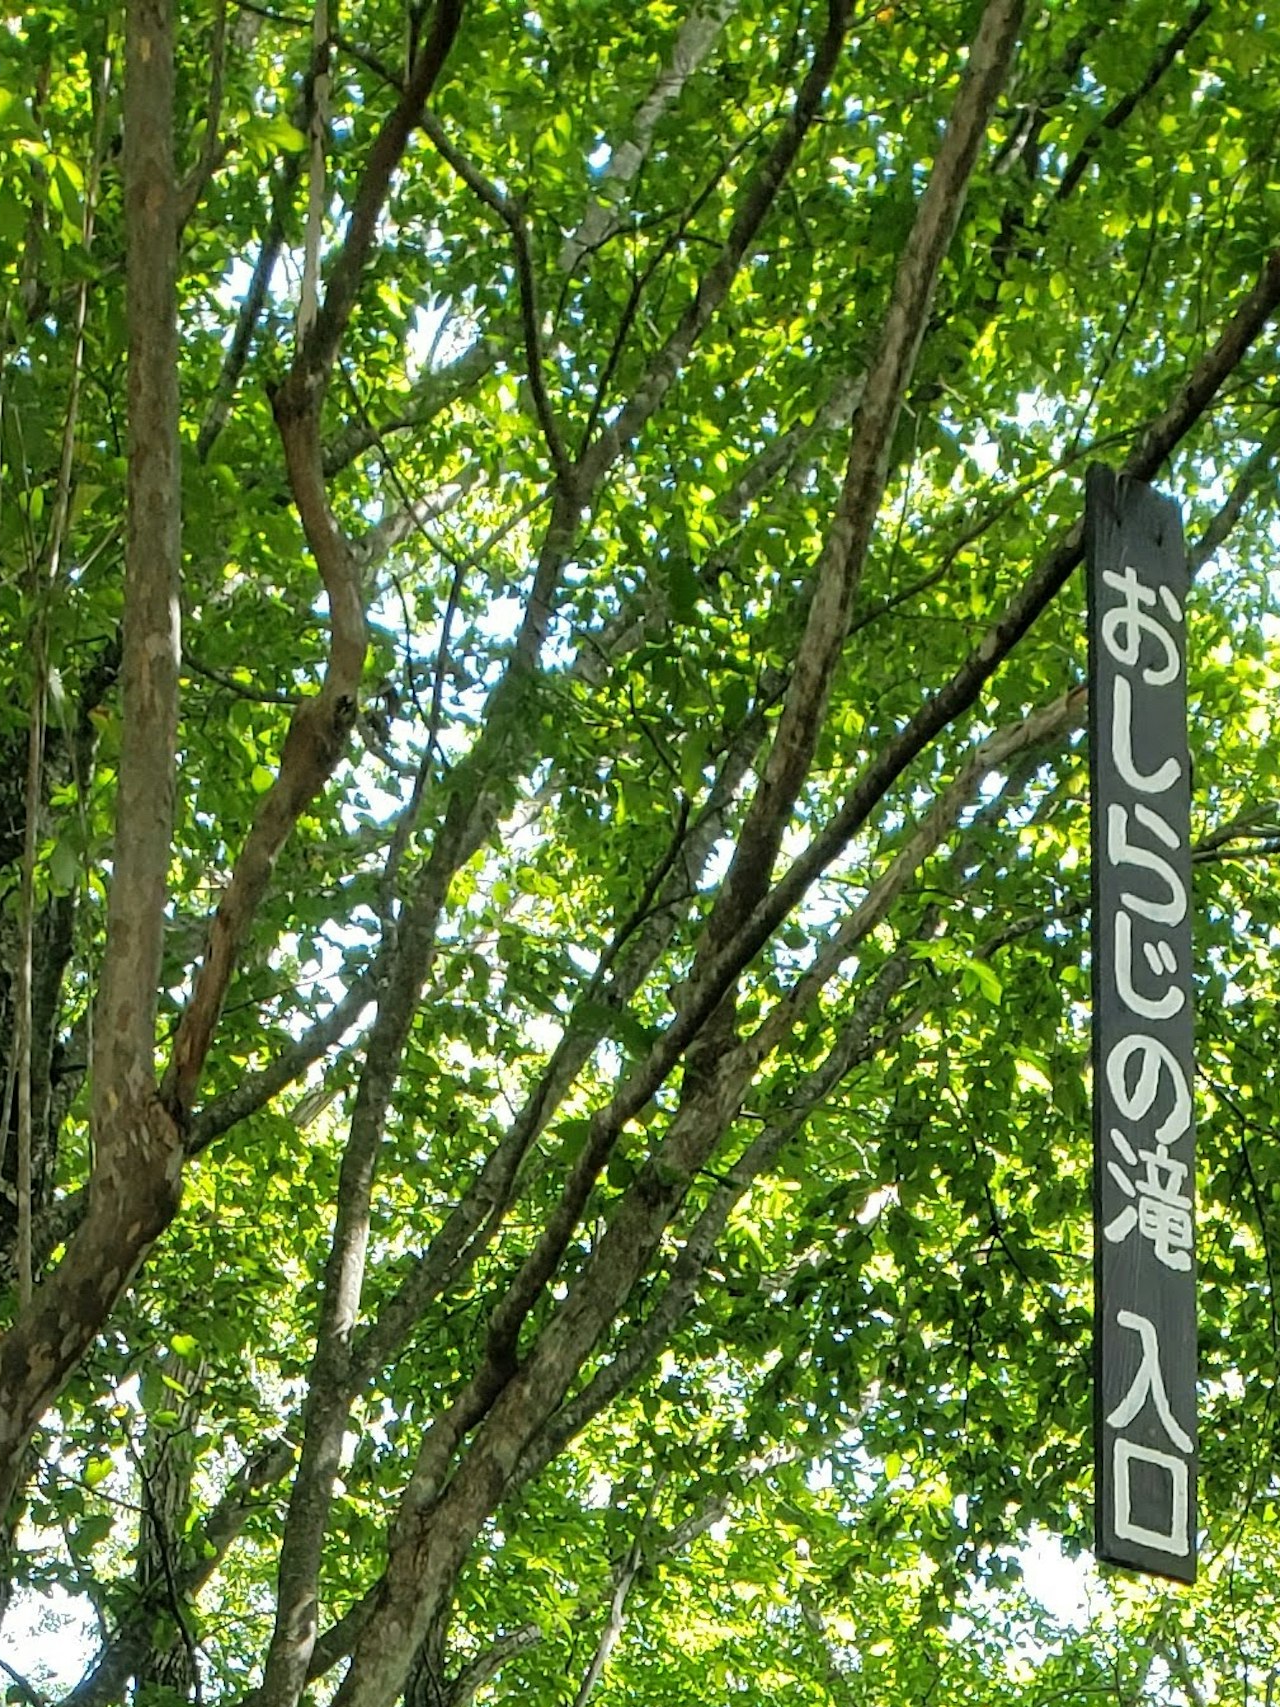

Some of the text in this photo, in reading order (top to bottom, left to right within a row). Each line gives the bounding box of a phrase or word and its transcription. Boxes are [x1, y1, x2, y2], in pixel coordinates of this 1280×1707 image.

[1101, 566, 1195, 1557] おしらじの滝 入口
